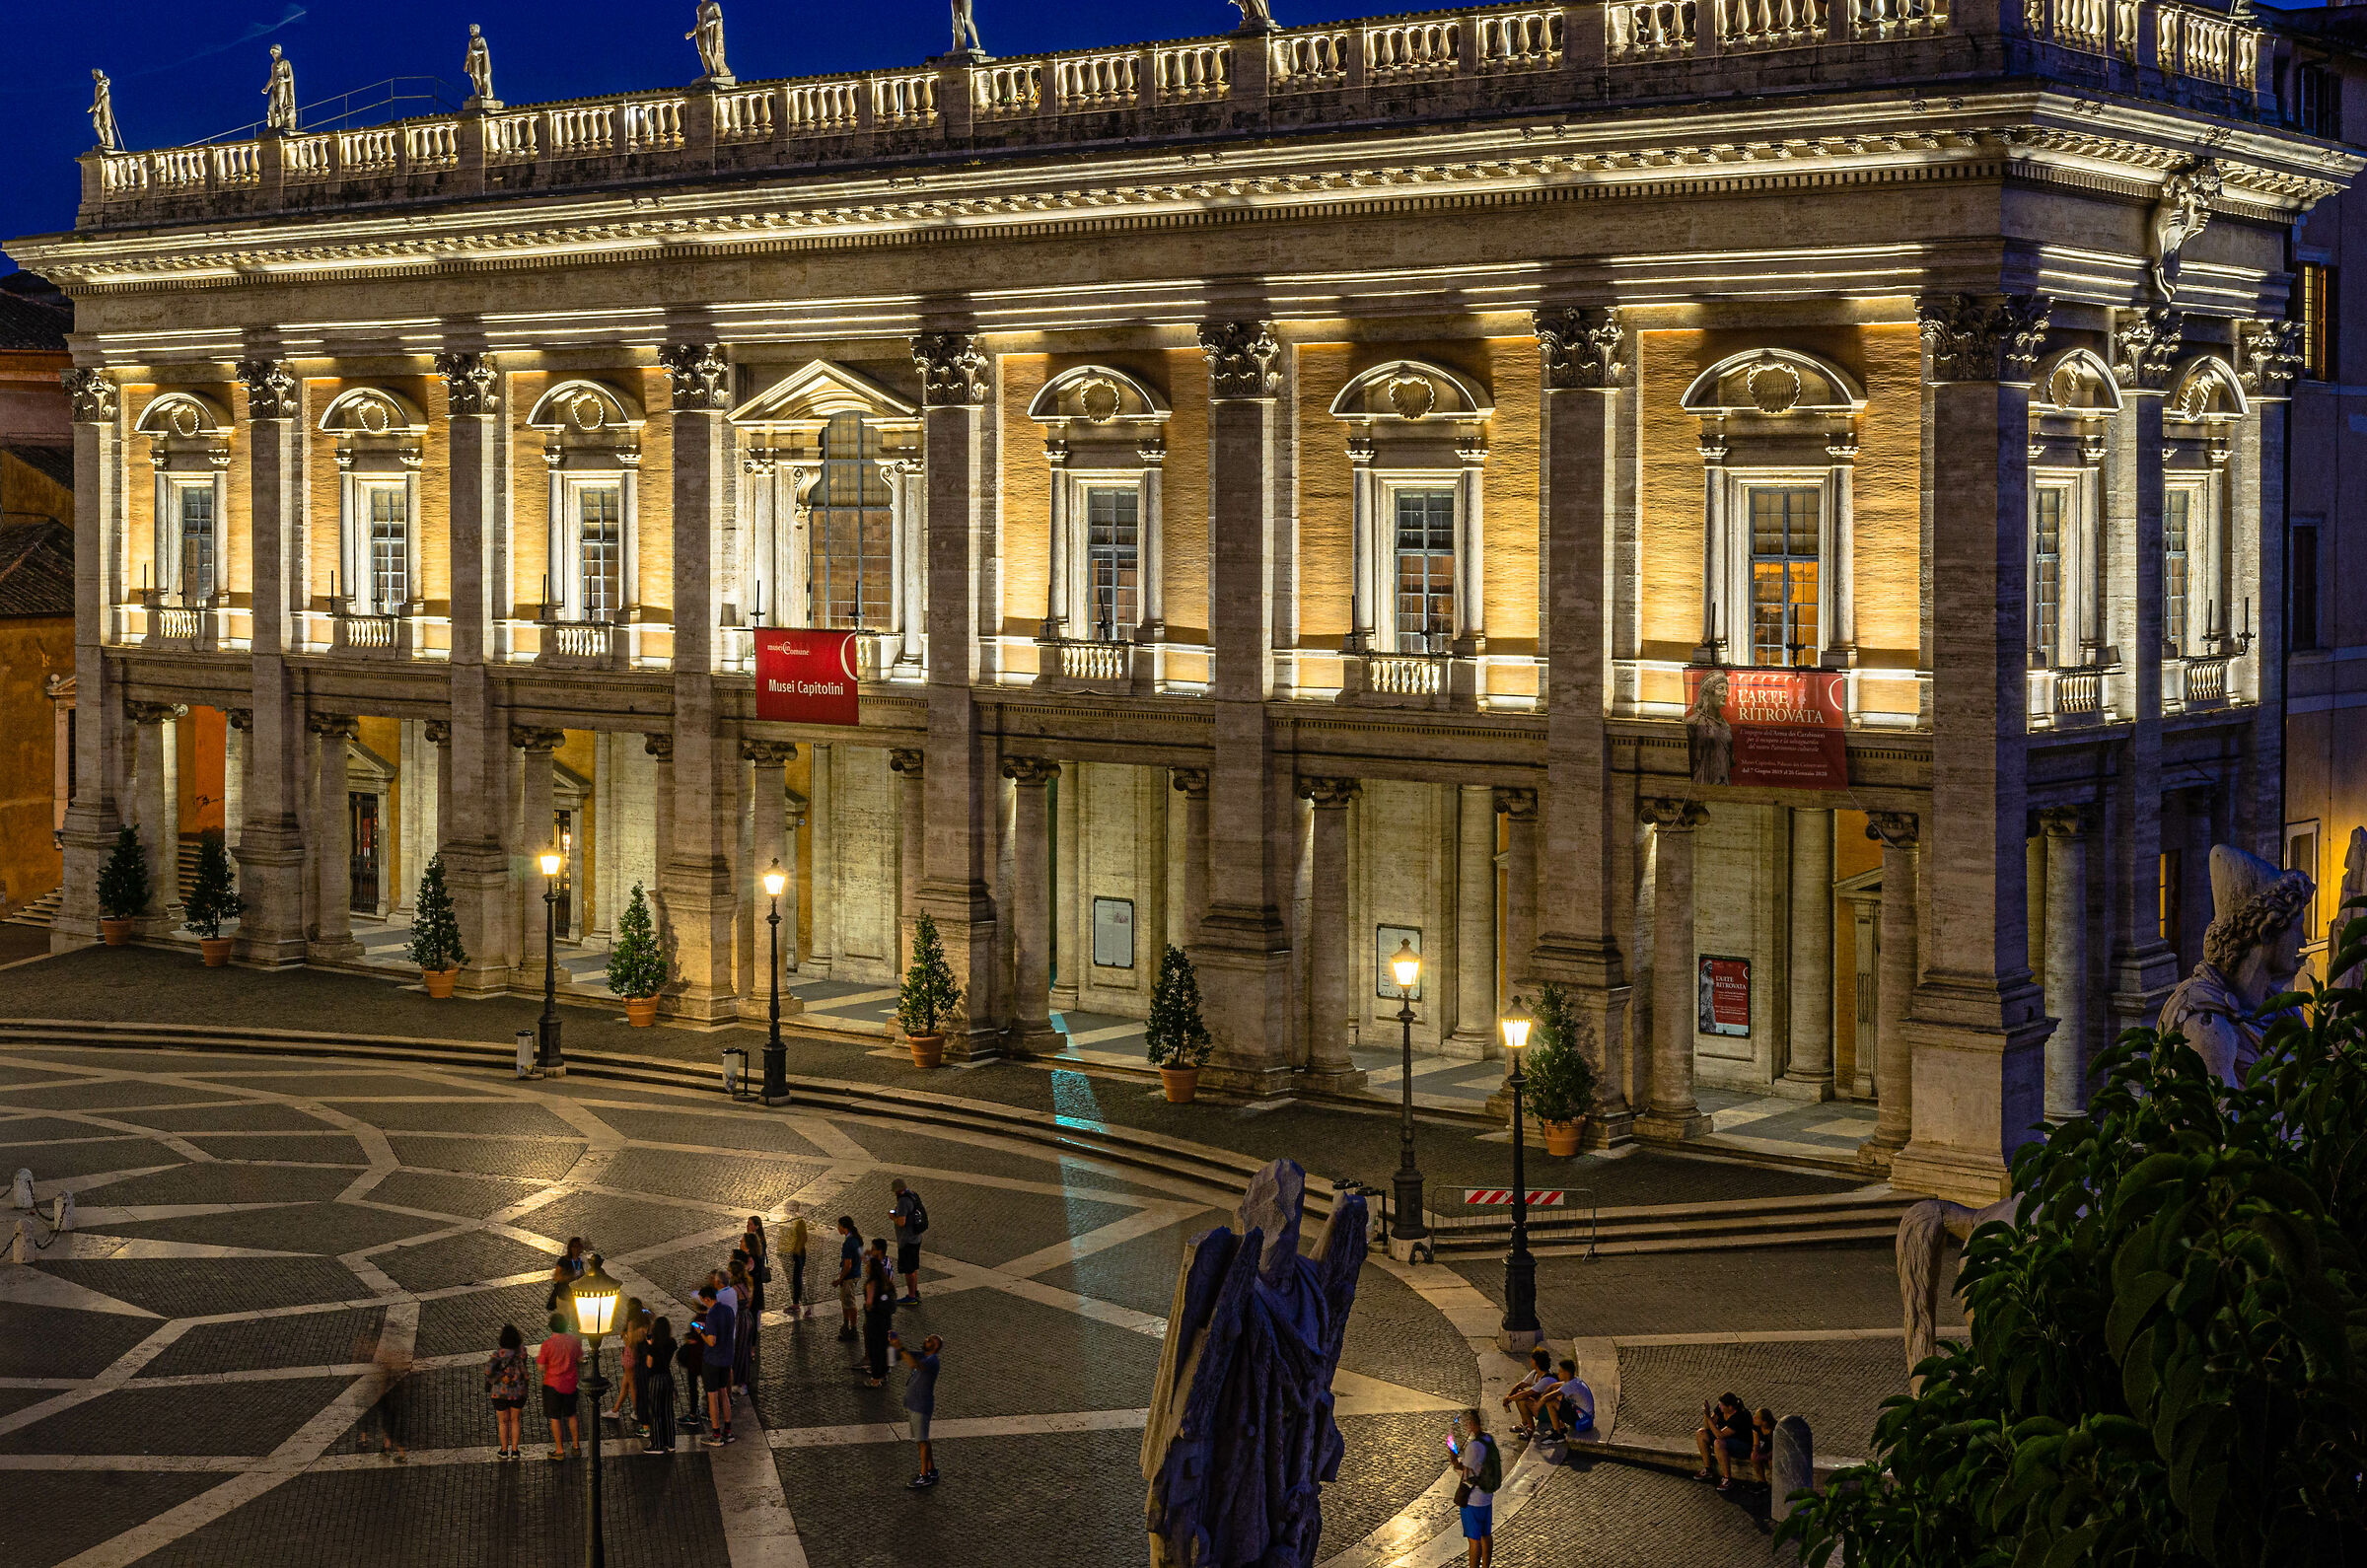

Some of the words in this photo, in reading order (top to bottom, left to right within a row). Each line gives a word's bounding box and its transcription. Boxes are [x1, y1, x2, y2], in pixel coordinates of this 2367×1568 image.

[769, 679, 795, 693] Musei
[798, 680, 843, 696] Capitolini
[1738, 689, 1789, 703] L'ARTE
[1739, 707, 1825, 723] RITROVATA
